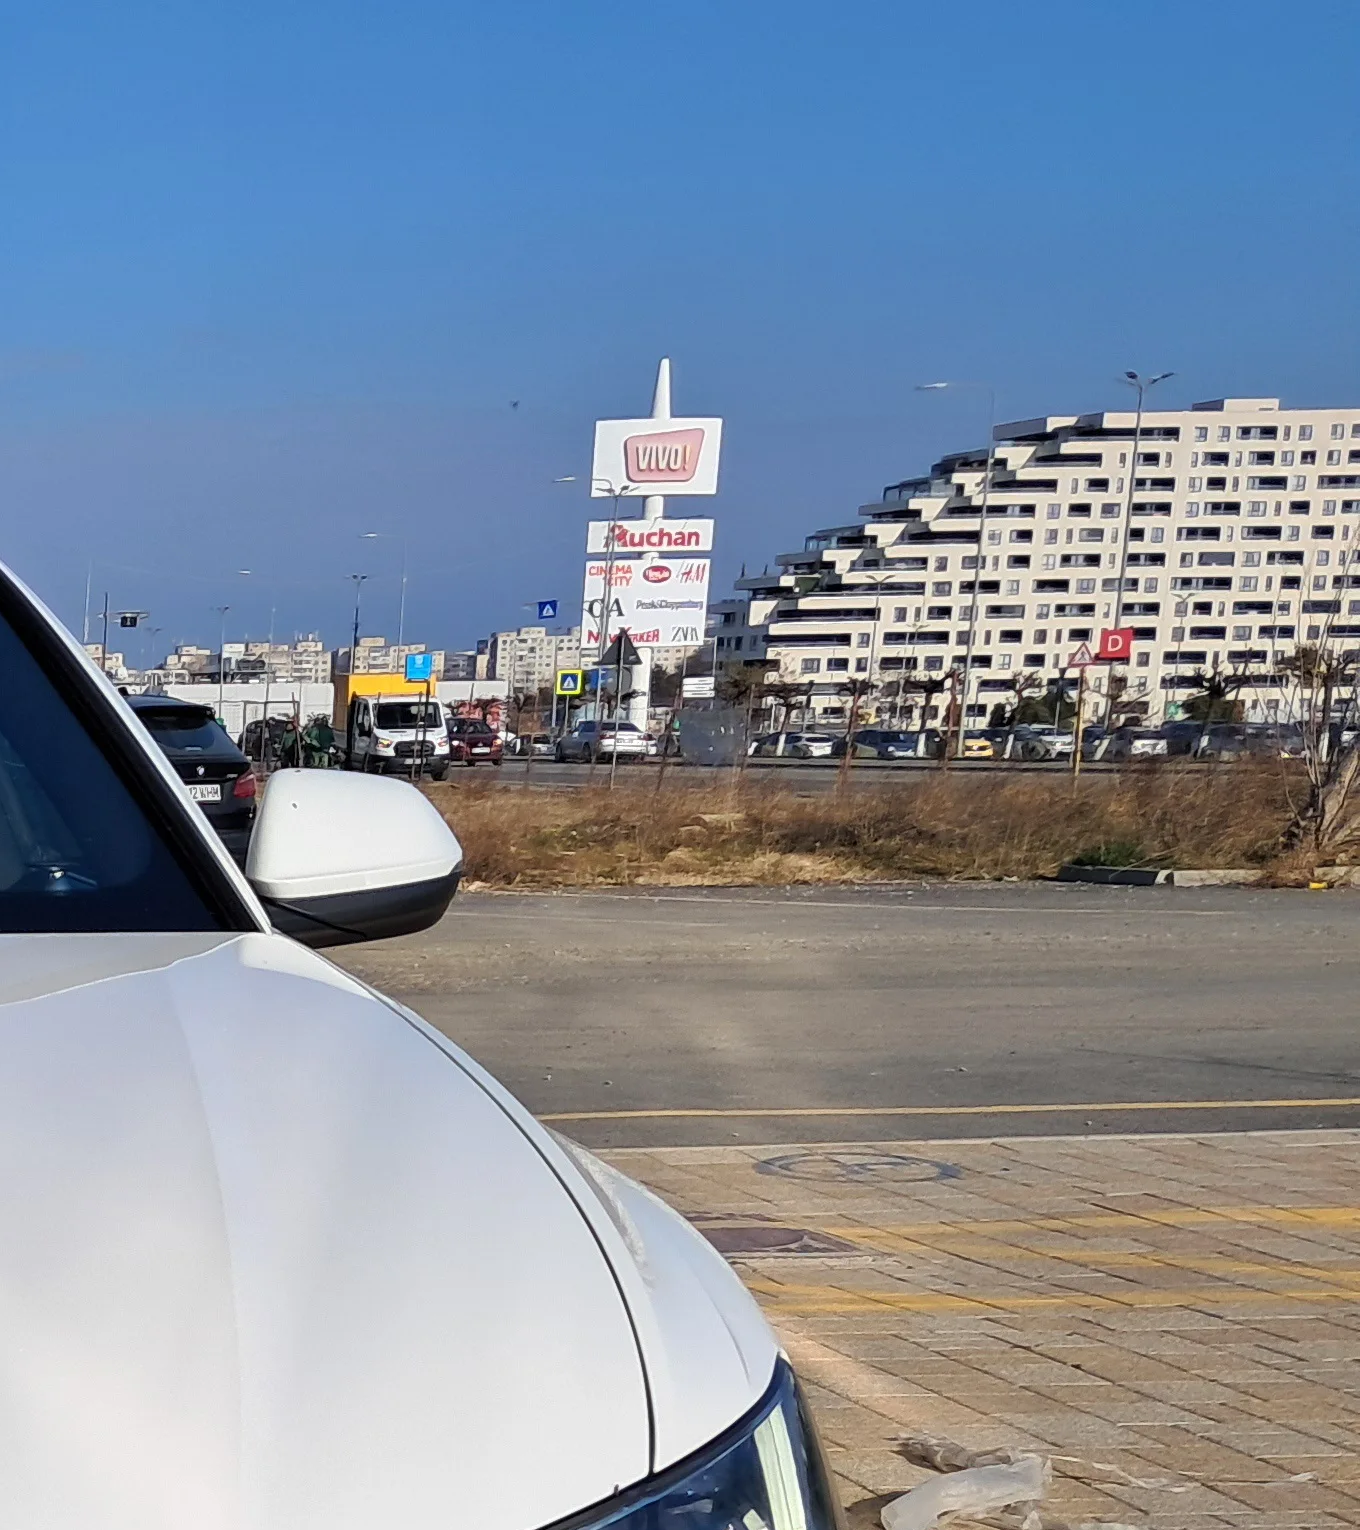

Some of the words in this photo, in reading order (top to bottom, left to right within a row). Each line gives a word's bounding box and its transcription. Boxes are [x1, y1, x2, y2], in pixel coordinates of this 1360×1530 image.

[636, 443, 691, 472] VIVO!
[603, 524, 701, 548] Auchan
[1107, 634, 1123, 652] D
